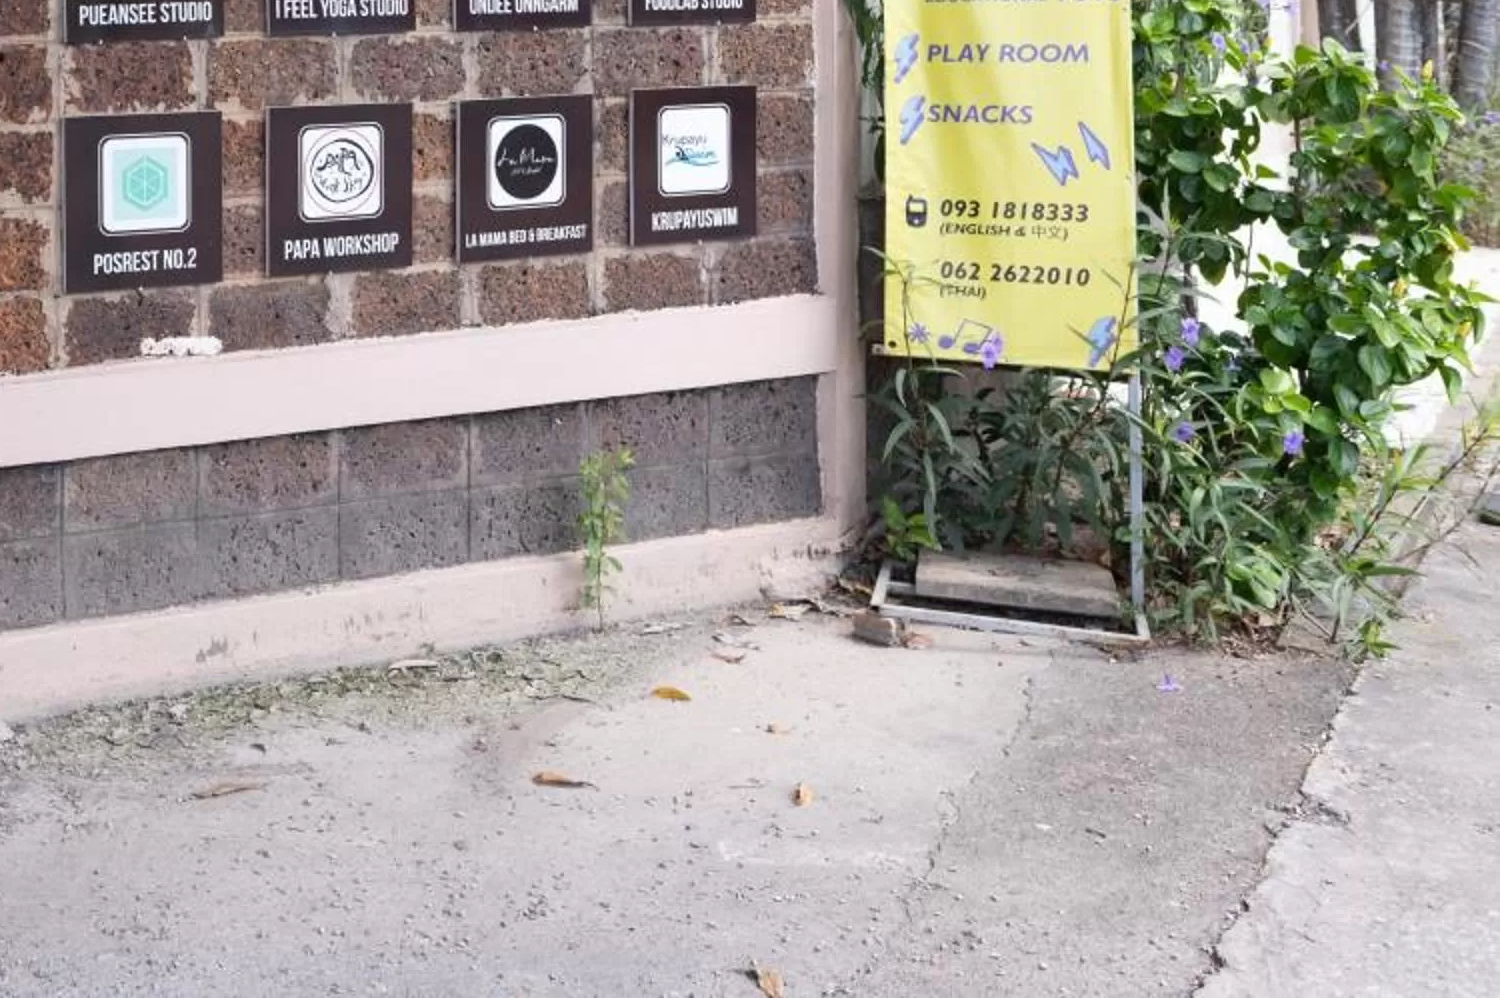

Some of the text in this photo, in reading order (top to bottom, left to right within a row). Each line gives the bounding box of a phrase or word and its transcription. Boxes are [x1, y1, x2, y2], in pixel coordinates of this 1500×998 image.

[79, 1, 213, 26] PUEANSEE STUDIO
[275, 0, 281, 19] I
[927, 43, 1089, 63] PLAY ROOM
[927, 105, 1033, 124] SNACKS
[652, 207, 739, 231] KRUPAYUSWIM
[940, 199, 1089, 222] 093 1818333
[465, 233, 477, 248] LA
[480, 230, 507, 247] MAMA
[509, 229, 527, 244] BED
[536, 223, 587, 242] BREAKFAST
[939, 223, 1011, 237] (ENGLISH
[1014, 226, 1026, 237] &
[284, 232, 399, 260] PAPA WORKSHOP
[93, 247, 197, 275] POSREST NO.2
[940, 261, 1090, 286] 062 2622010
[939, 284, 987, 299] (THAI)
